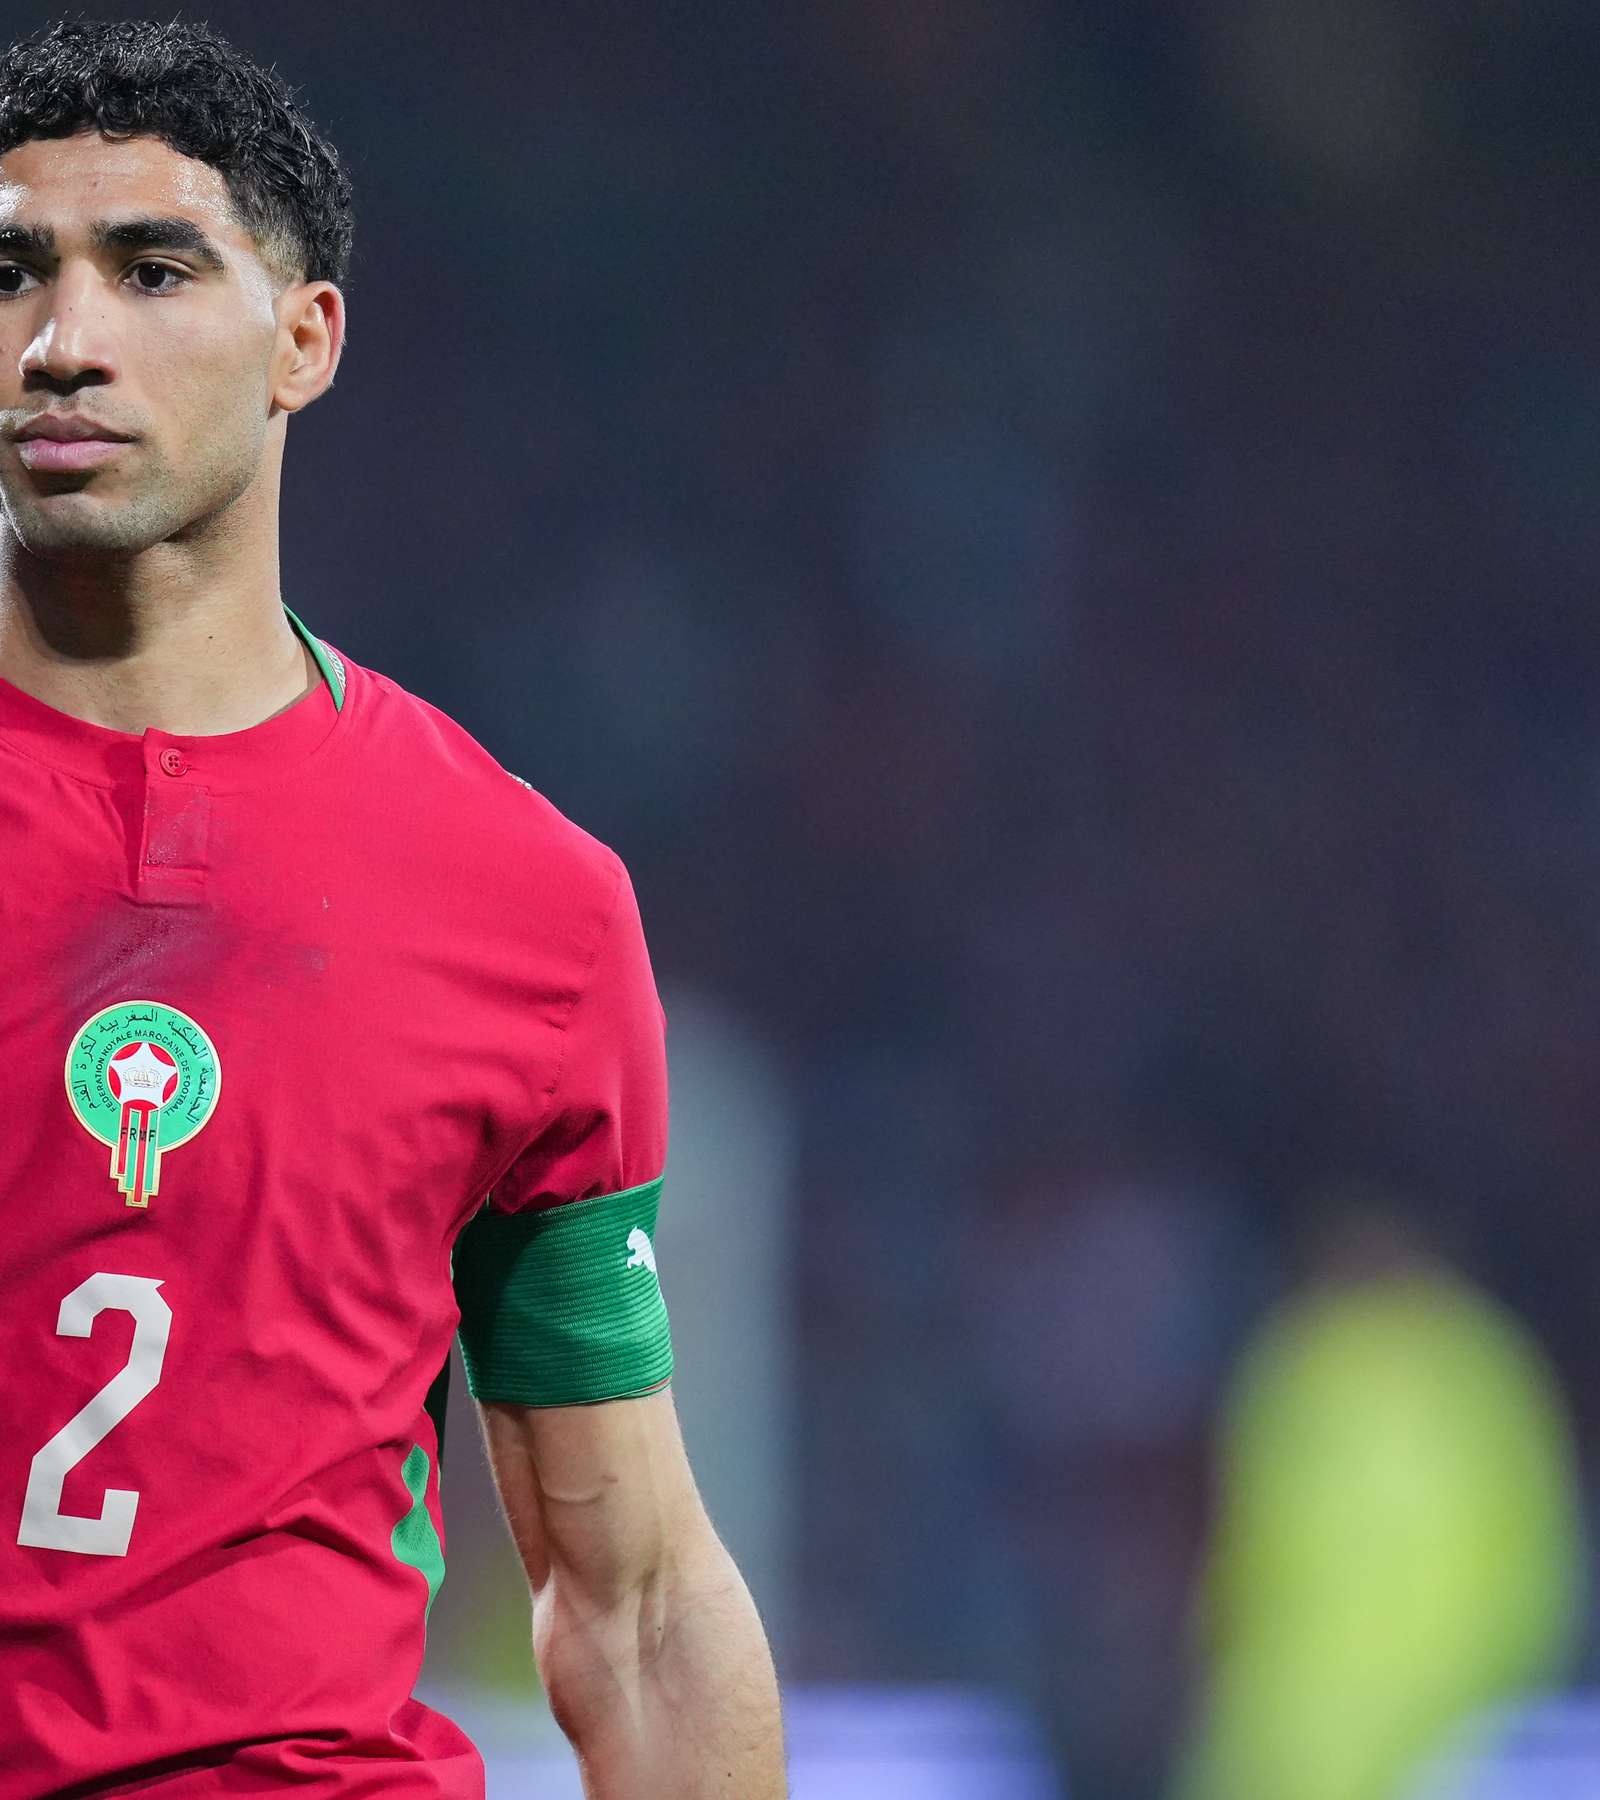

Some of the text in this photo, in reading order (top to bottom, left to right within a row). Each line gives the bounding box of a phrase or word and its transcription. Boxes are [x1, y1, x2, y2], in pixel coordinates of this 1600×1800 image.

[101, 1030, 133, 1057] ROYALE
[134, 1029, 185, 1059] MAROCAINE
[73, 1008, 214, 1124] الجامعة الملكية المغربية لكرة القدم
[180, 1059, 191, 1073] DE
[163, 1074, 191, 1116] FOOTBALL
[120, 1126, 157, 1143] FRMF
[16, 1271, 173, 1558] 2
